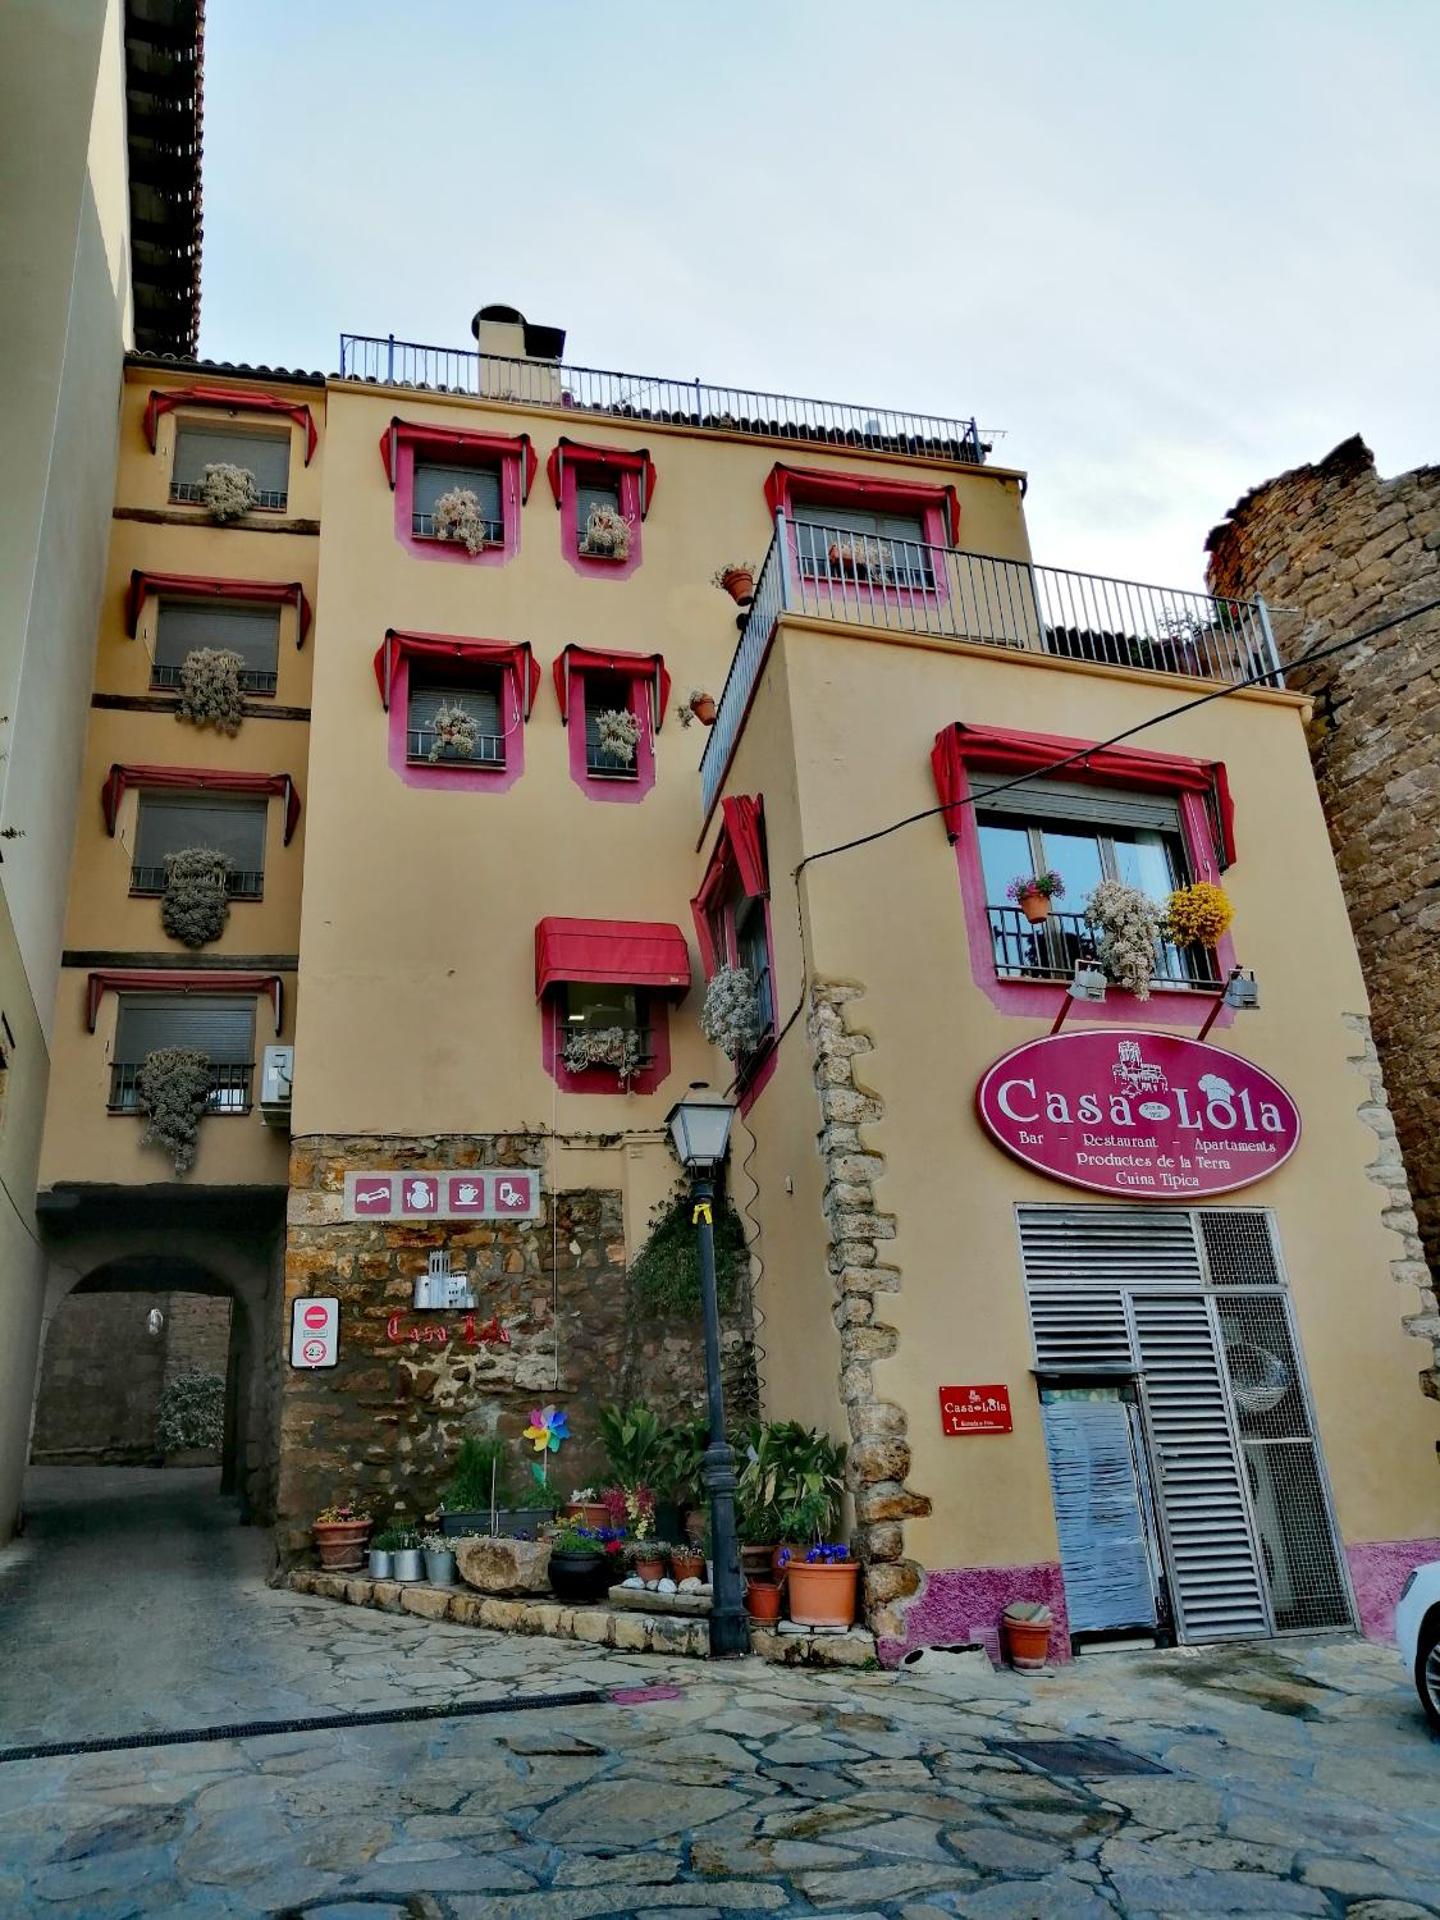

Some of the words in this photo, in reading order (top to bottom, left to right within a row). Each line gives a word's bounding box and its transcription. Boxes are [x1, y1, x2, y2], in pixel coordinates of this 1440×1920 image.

[997, 1078, 1136, 1127] Casa
[1171, 1088, 1286, 1132] Lola
[1019, 1131, 1044, 1144] Bar
[1083, 1133, 1159, 1148] Restaurant
[1195, 1137, 1276, 1153] Apartaments
[1076, 1152, 1152, 1167] Productes
[1157, 1154, 1175, 1168] de
[1180, 1155, 1191, 1168] la
[1195, 1156, 1231, 1169] Terra
[1115, 1171, 1155, 1185] Cuina
[387, 1310, 447, 1343] Casa
[944, 1402, 974, 1413] Casa
[982, 1401, 1007, 1412] Lola
